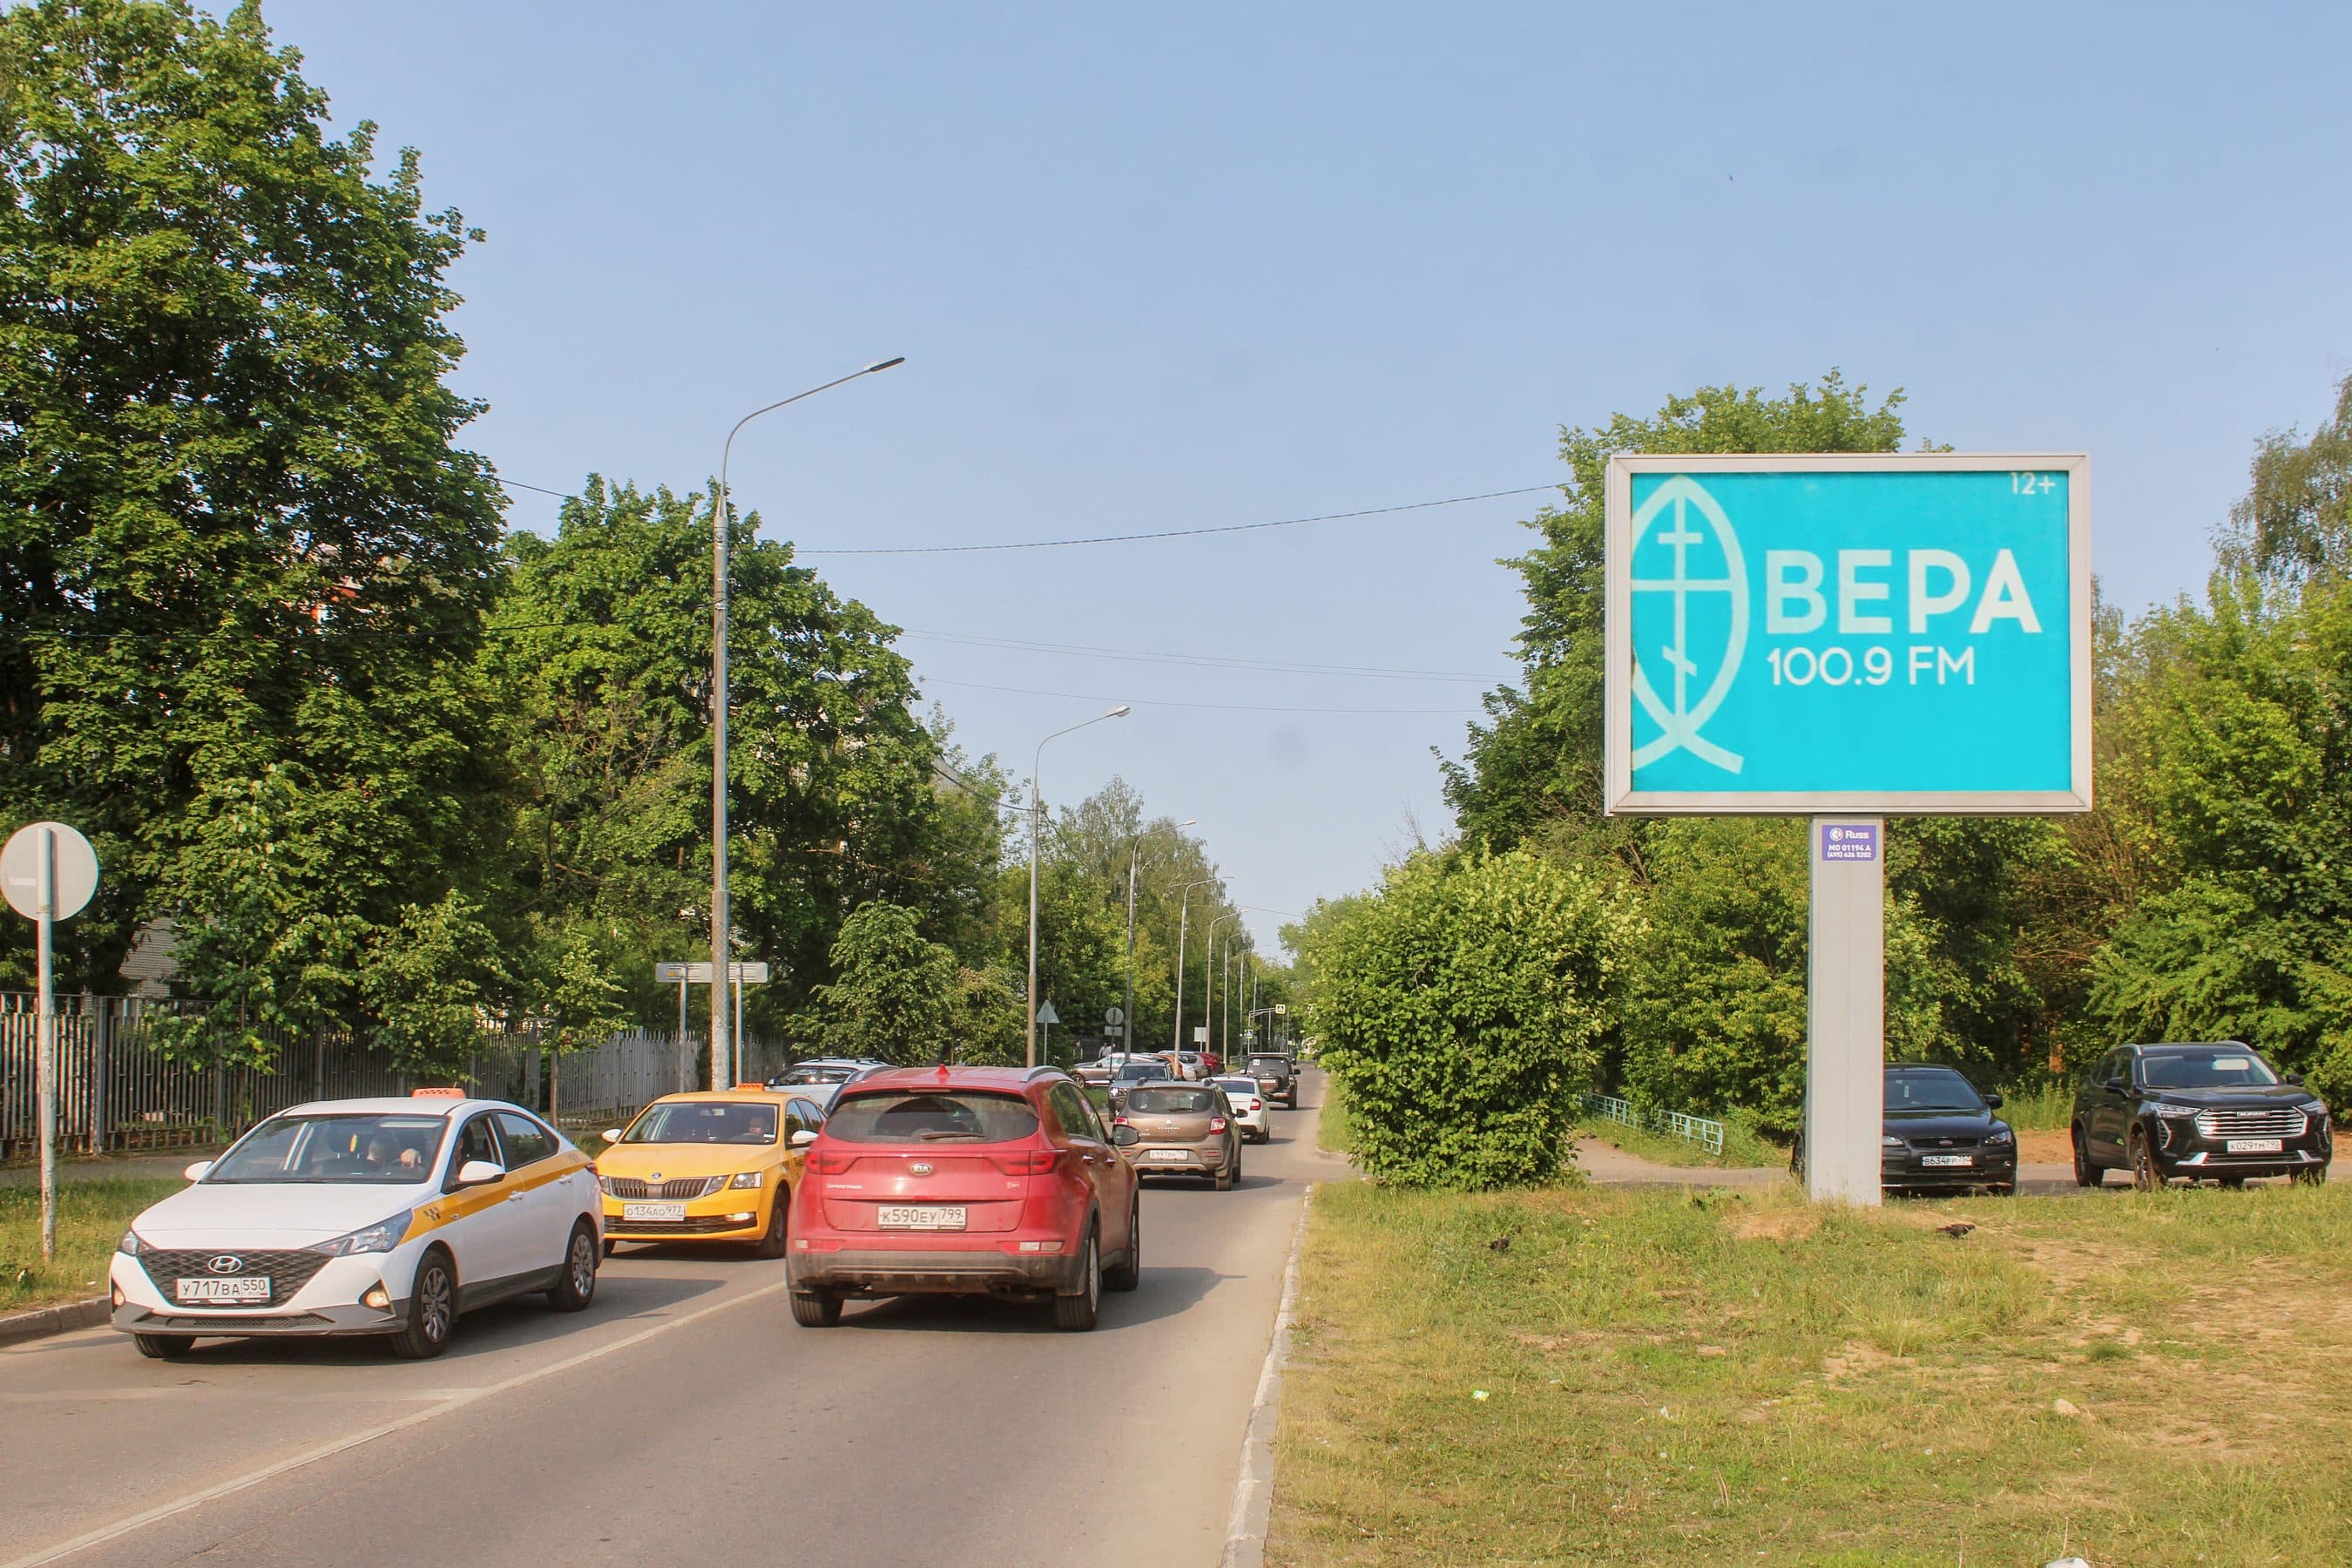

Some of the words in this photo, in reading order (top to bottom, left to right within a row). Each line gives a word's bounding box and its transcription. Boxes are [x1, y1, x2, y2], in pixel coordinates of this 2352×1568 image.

[2010, 471, 2056, 495] 12+
[1766, 548, 2043, 634] ВЕРА
[1767, 645, 1893, 686] 100.9
[1909, 645, 1975, 686] FM
[1845, 829, 1869, 839] Russ
